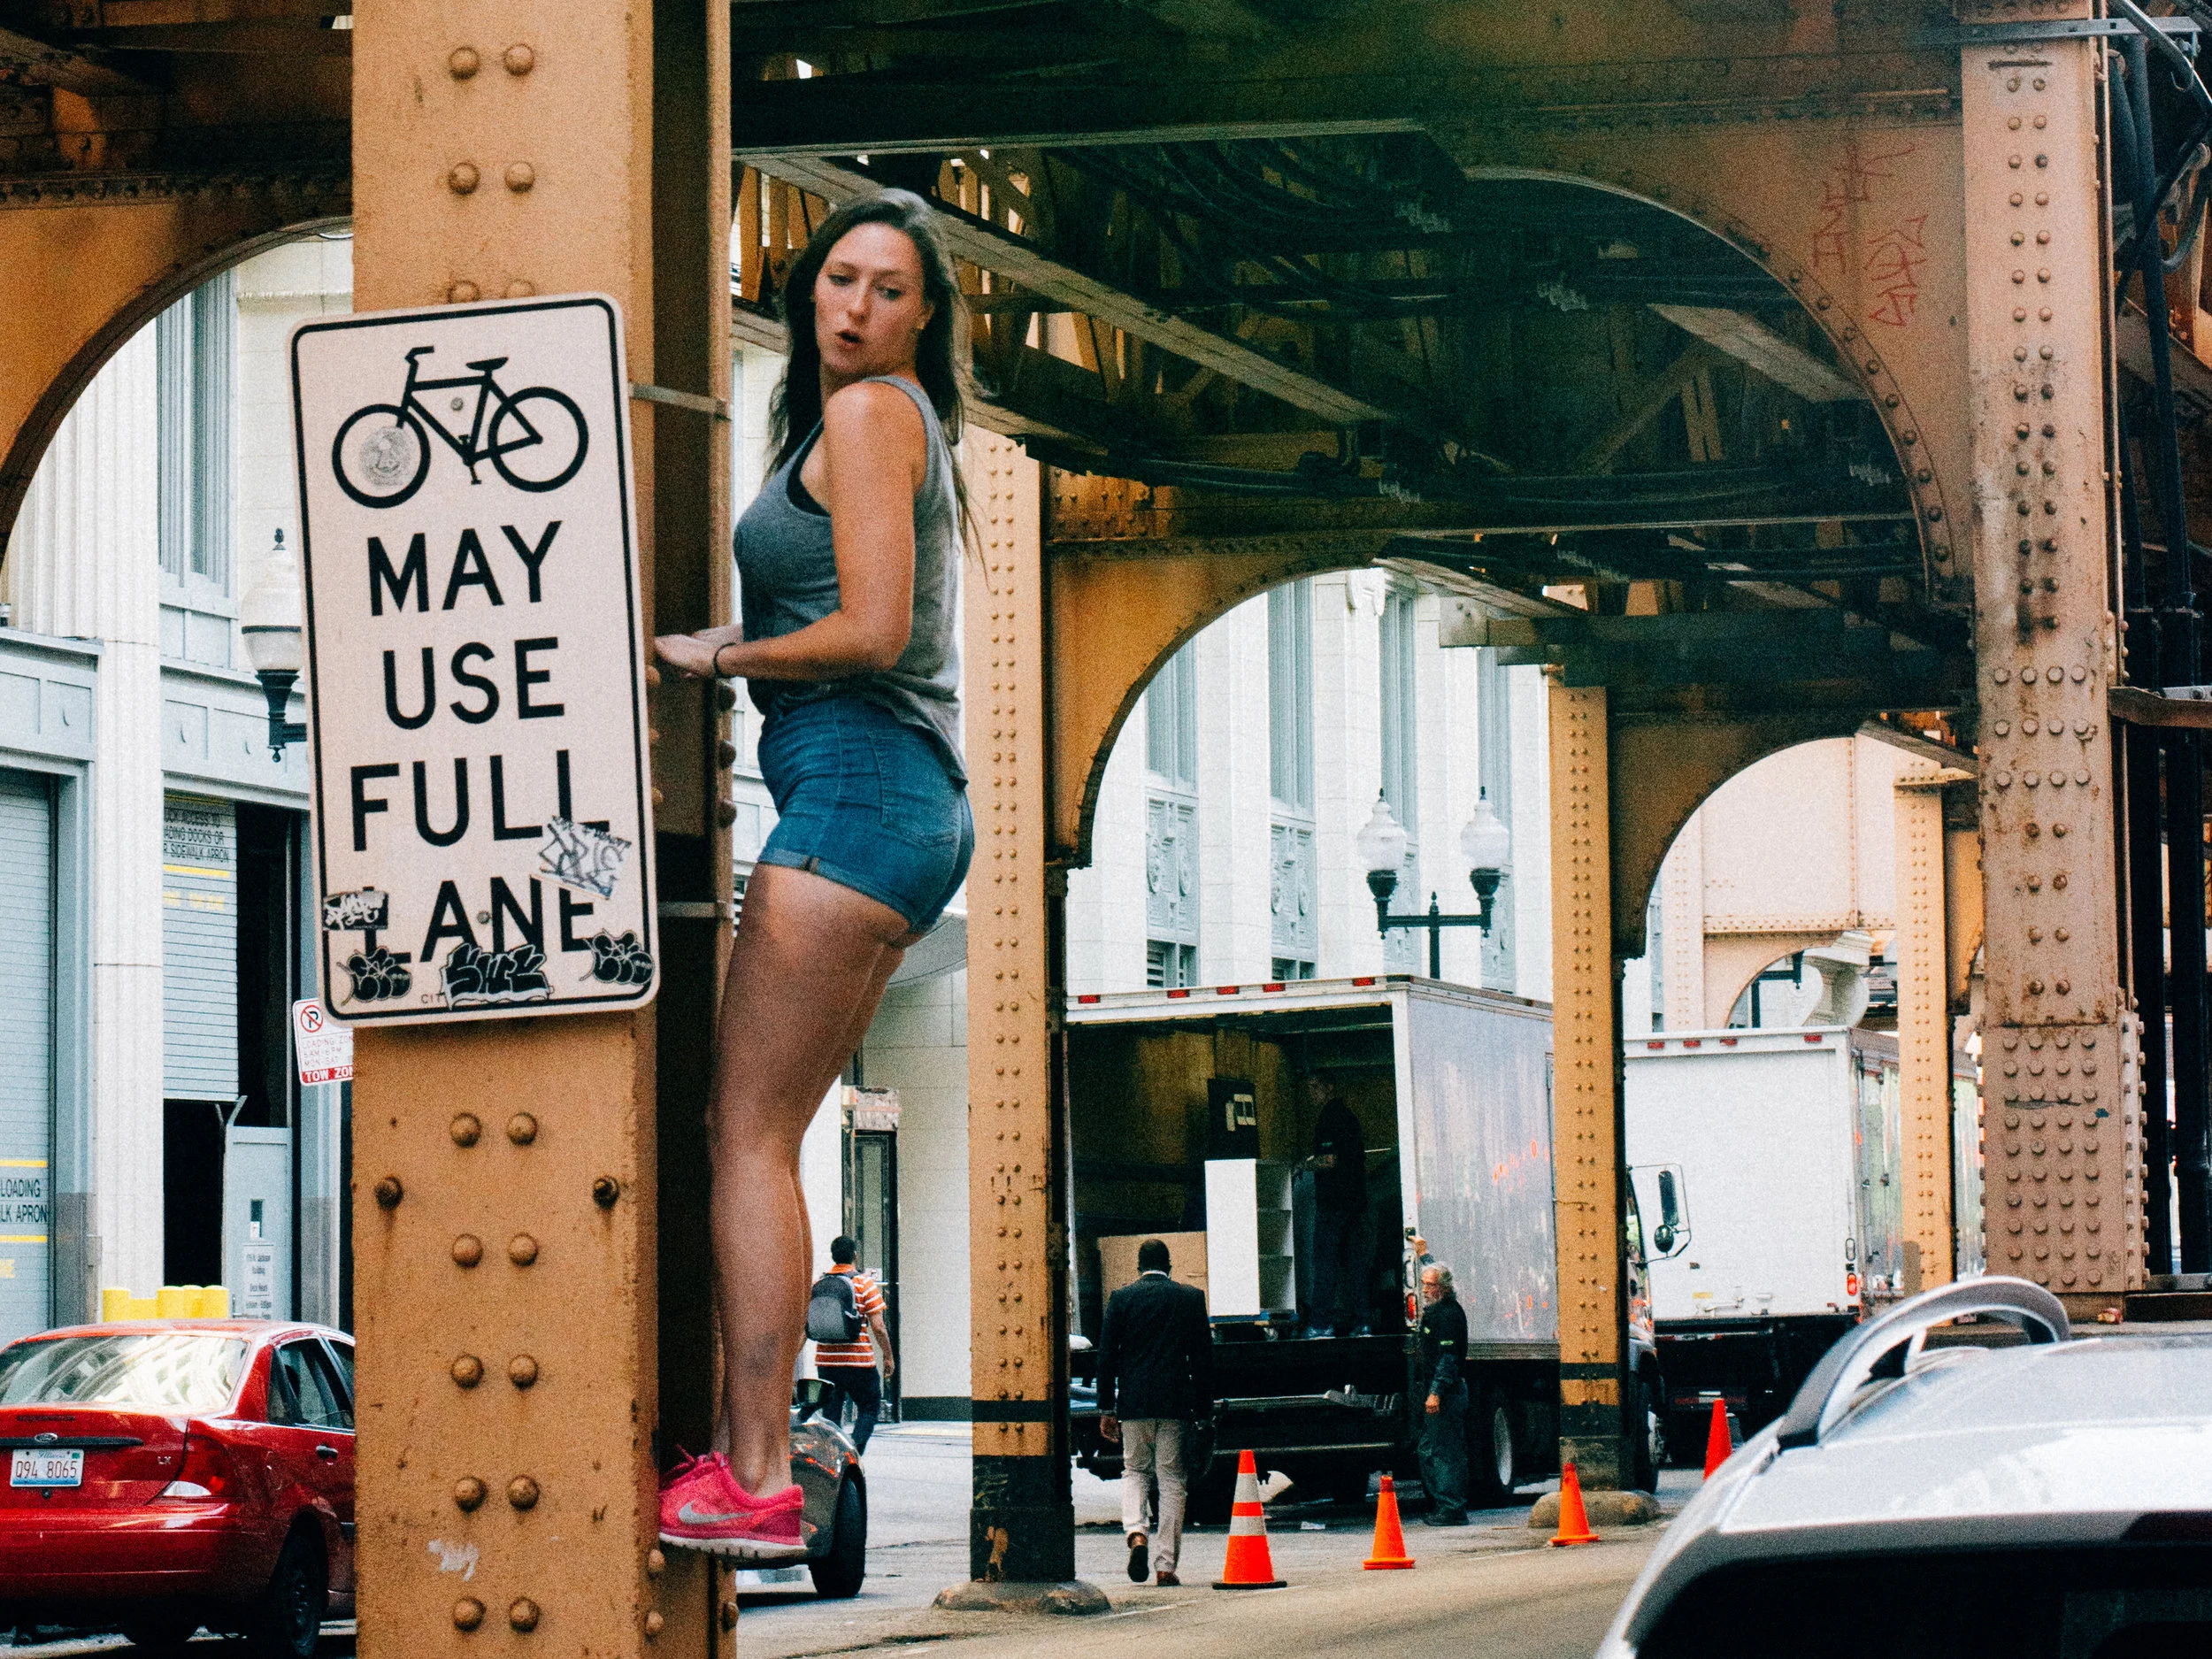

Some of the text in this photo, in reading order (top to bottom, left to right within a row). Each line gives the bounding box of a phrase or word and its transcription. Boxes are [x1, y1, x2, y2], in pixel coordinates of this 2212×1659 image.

[367, 520, 563, 616] MAY
[383, 637, 565, 730] USE
[350, 749, 610, 851] FULL
[188, 828, 212, 844] DOCKS
[171, 843, 204, 860] SIDEWALK
[207, 848, 229, 864] APRON
[362, 876, 595, 964] LANE
[305, 1069, 329, 1082] TOW
[1, 1179, 41, 1198] LOADING
[16, 1204, 48, 1223] APRON
[46, 1461, 78, 1479] 8065
